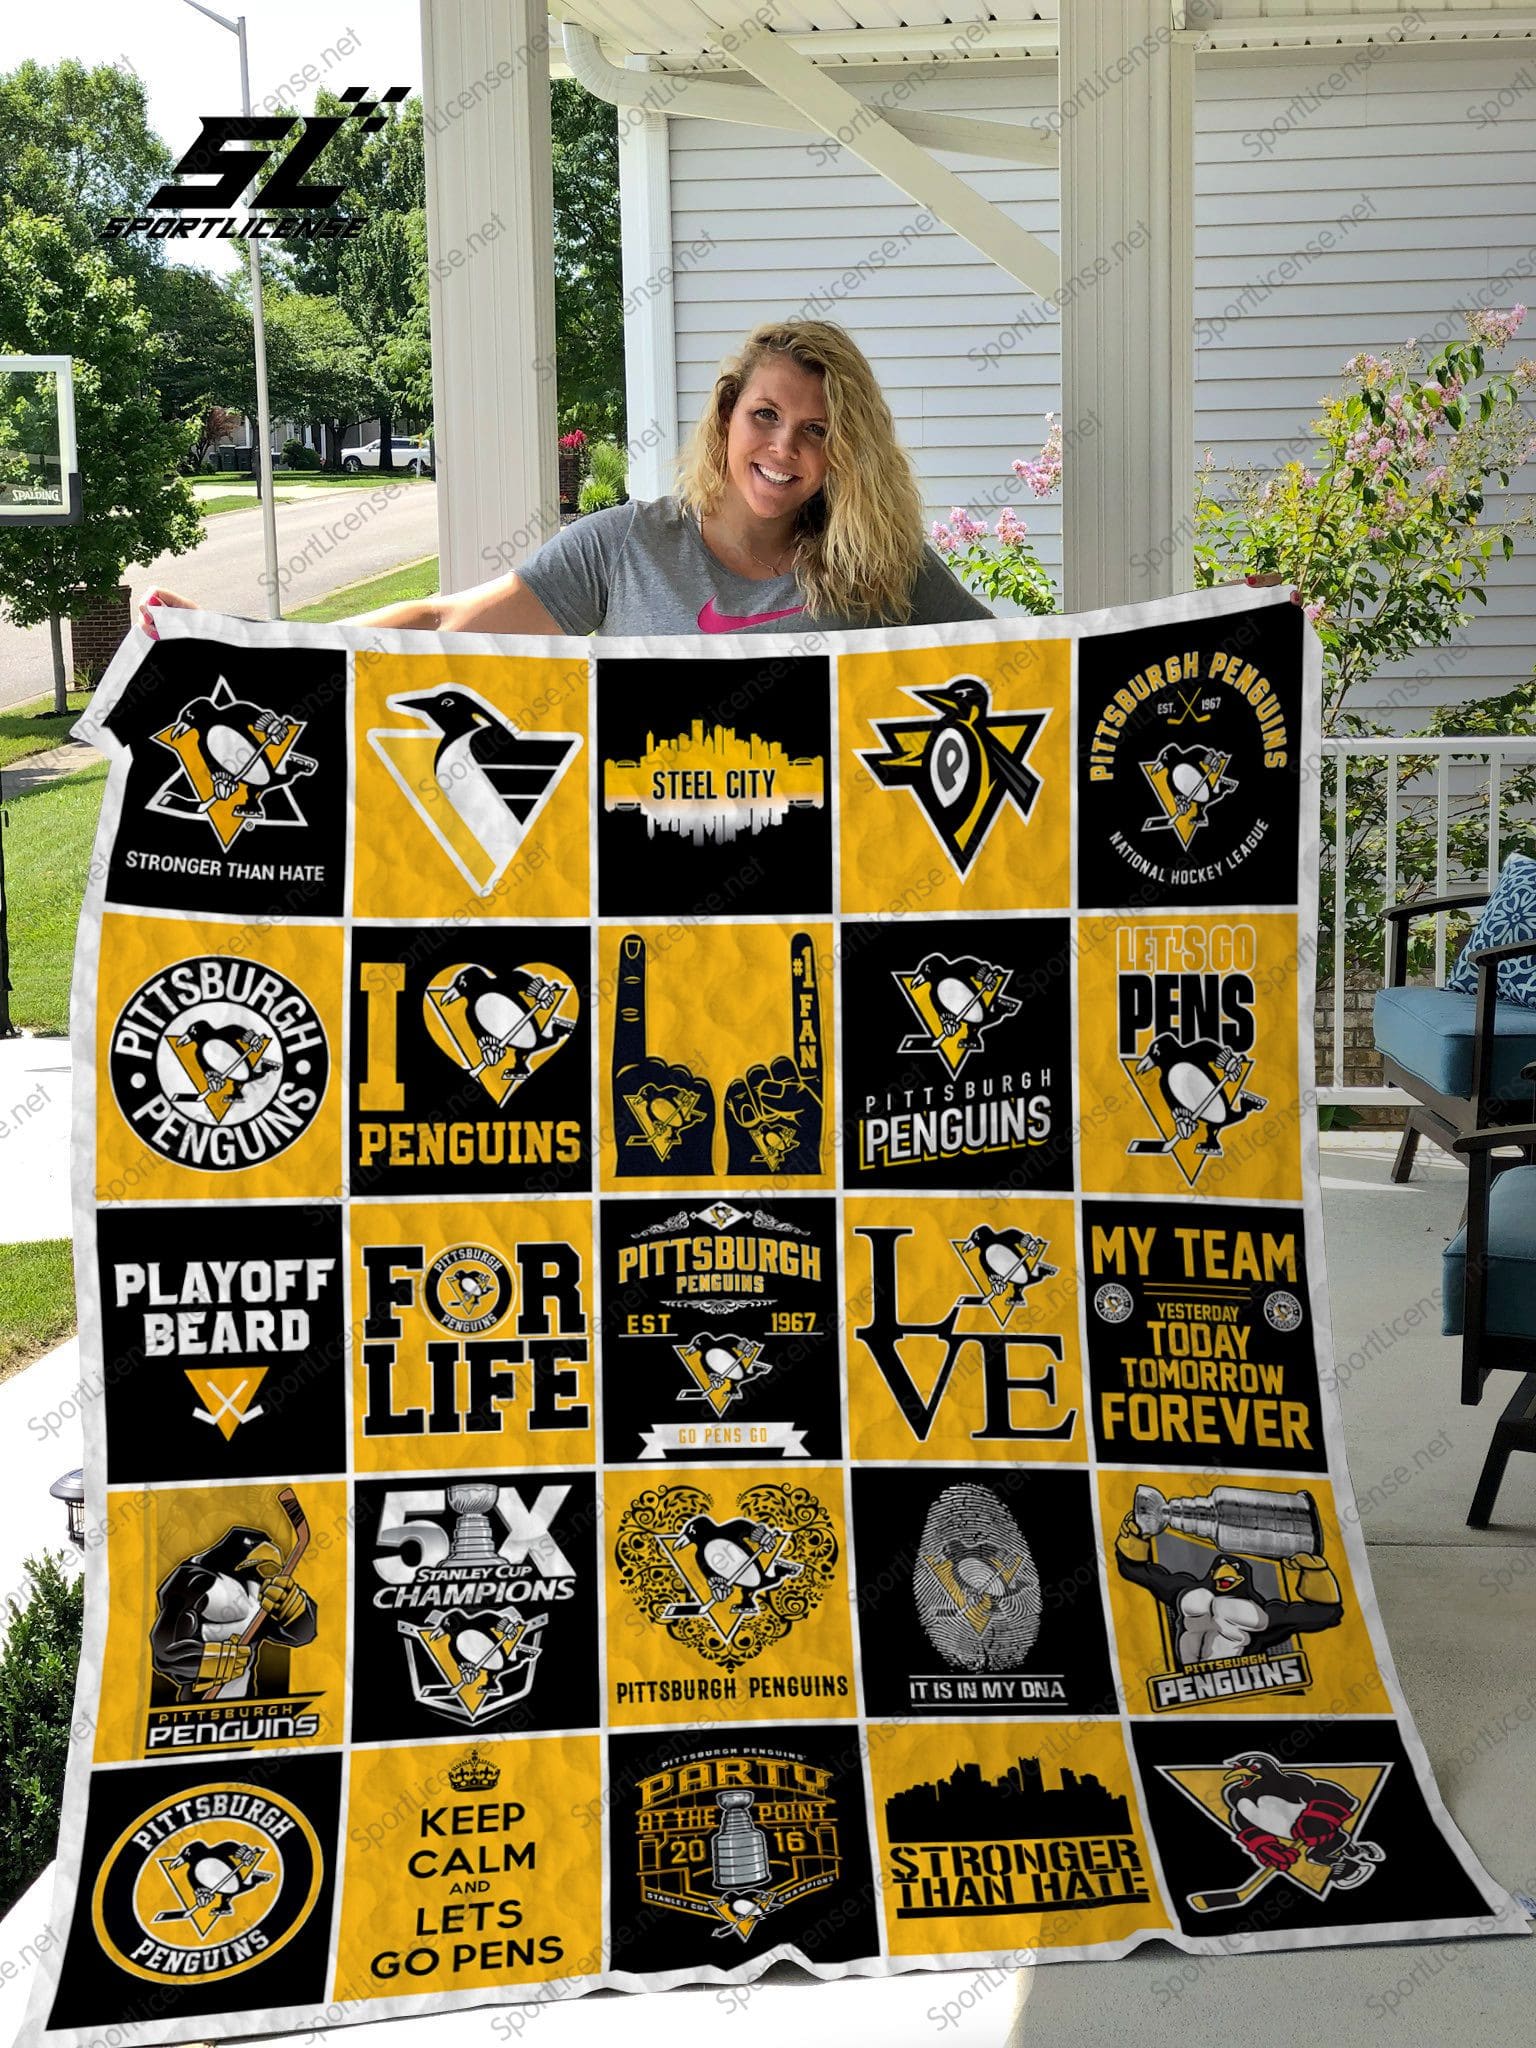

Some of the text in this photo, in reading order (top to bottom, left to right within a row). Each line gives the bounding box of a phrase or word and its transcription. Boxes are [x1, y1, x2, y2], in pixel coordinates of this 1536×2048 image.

[12, 489, 61, 502] SPALDING
[1090, 651, 1288, 781] PITTSBURGH PENGUINS
[1157, 697, 1221, 714] EST. 1967
[652, 769, 776, 800] STEEL CITY
[125, 850, 222, 877] STRONGER
[226, 861, 275, 881] THAN
[279, 865, 325, 882] HATE
[1109, 818, 1269, 885] NATIONAL HOCKEY LEAGUE
[1209, 924, 1256, 972] GO
[114, 961, 323, 1060] PITTSBURGH
[1118, 973, 1256, 1057] PENS
[359, 963, 406, 1111] I
[866, 1068, 1050, 1113] PITTSBURGH
[132, 1082, 317, 1166] PENGUINS
[861, 1095, 1051, 1168] PENGUINS
[359, 1121, 580, 1166] PENGUINS
[433, 1248, 503, 1273] PITTSBURGH
[618, 1236, 821, 1284] PITTSBURGH
[1091, 1225, 1297, 1283] MY TEAM
[114, 1258, 336, 1307] PLAYOFF
[676, 1274, 765, 1294] PENGUINS
[441, 1313, 498, 1332] PENGUINS
[627, 1312, 817, 1334] EST 1967
[1157, 1302, 1239, 1322] YESTERDAY
[143, 1309, 310, 1356] BEARD
[1146, 1321, 1251, 1360] TODAY
[361, 1337, 591, 1438] LIFE
[1120, 1357, 1284, 1395] TOMORROW
[678, 1427, 768, 1444] GO PENS GO
[1101, 1392, 1313, 1450] FOREVER
[416, 1565, 533, 1583] STANLEY CUP
[372, 1578, 576, 1609] CHAMPIONS
[1157, 1658, 1303, 1706] PENGUINS
[1183, 1653, 1268, 1675] PITTSBURGH
[616, 1675, 849, 1704] PITTSBURGH PENGUINS
[909, 1681, 1066, 1699] IT IS IN MY DNA
[148, 1715, 318, 1748] PENGUINS
[158, 1705, 293, 1724] PITTSBURGH
[661, 1748, 738, 1768] PITTSBURGH
[635, 1758, 834, 1810] PARTY
[132, 1794, 296, 1851] PITTSBURGH
[420, 1802, 526, 1838] KEEP
[639, 1803, 827, 1831] AT THE POINT
[407, 1842, 536, 1879] CALM
[890, 1838, 1143, 1879] STRONGER
[448, 1880, 491, 1895] AND
[778, 1876, 834, 1903] CHAMPIONS
[892, 1868, 1150, 1907] THAN HATE
[416, 1899, 523, 1936] LETS
[129, 1929, 269, 1973] PENGUINS
[370, 1936, 564, 1980] GO PENS
